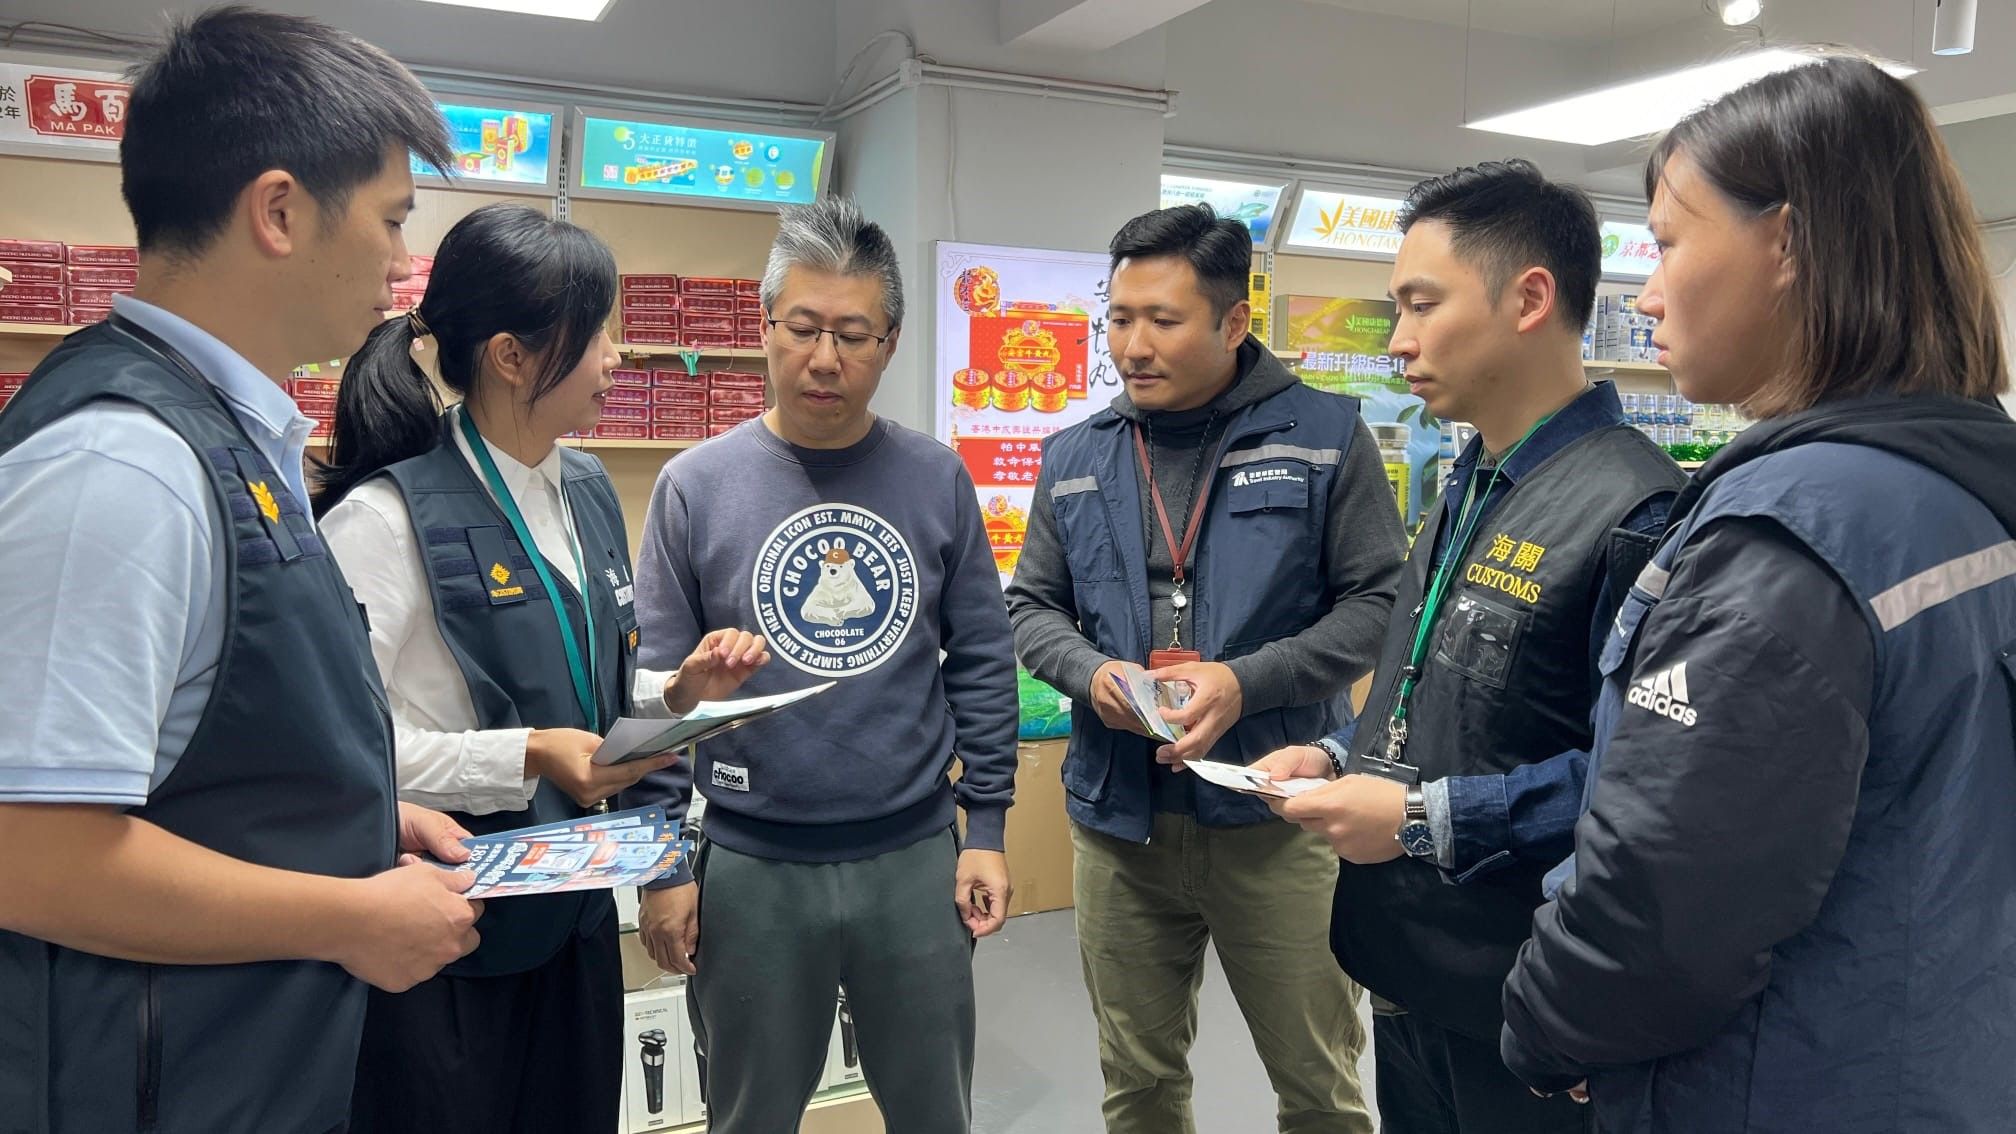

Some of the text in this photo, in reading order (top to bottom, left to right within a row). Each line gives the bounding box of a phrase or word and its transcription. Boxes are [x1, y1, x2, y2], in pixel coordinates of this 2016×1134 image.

[50, 121, 116, 136] MA PAK
[993, 470, 1037, 482] 孝敬老
[782, 536, 891, 597] CHOCOO BEAR
[1486, 532, 1546, 574] 海關
[759, 511, 913, 669] ORIGINAL ICON EST. MMVI LETS JUST KEEP EVERYTHING SIMPLE AND NEAT
[1466, 563, 1542, 604] CUSTOMS
[814, 628, 865, 639] CHOCOOLATE
[834, 638, 846, 646] 06
[1628, 686, 1698, 727] adidas
[714, 768, 744, 785] chocoo
